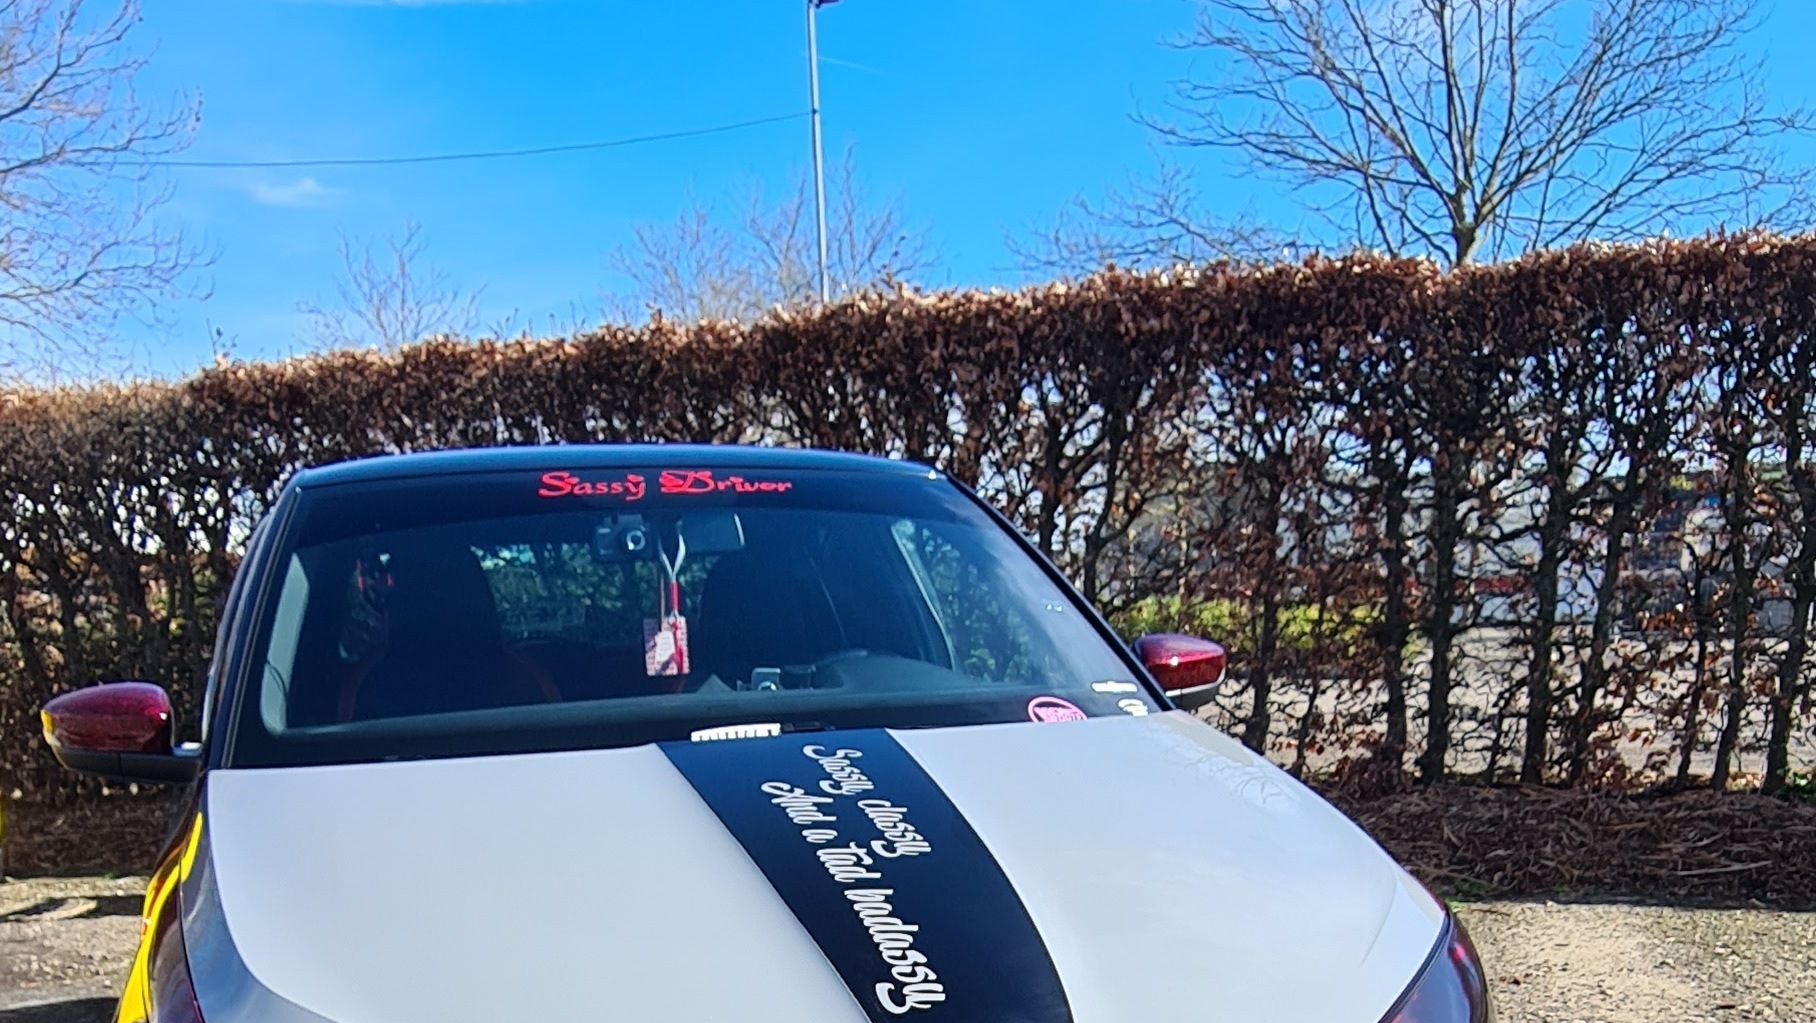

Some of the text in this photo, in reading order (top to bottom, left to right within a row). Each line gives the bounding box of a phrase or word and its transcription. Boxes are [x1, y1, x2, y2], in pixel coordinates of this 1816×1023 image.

[537, 469, 793, 501] Sassy Driver
[802, 744, 932, 858] Sassy classy
[760, 781, 946, 1015] And a tad badassy
